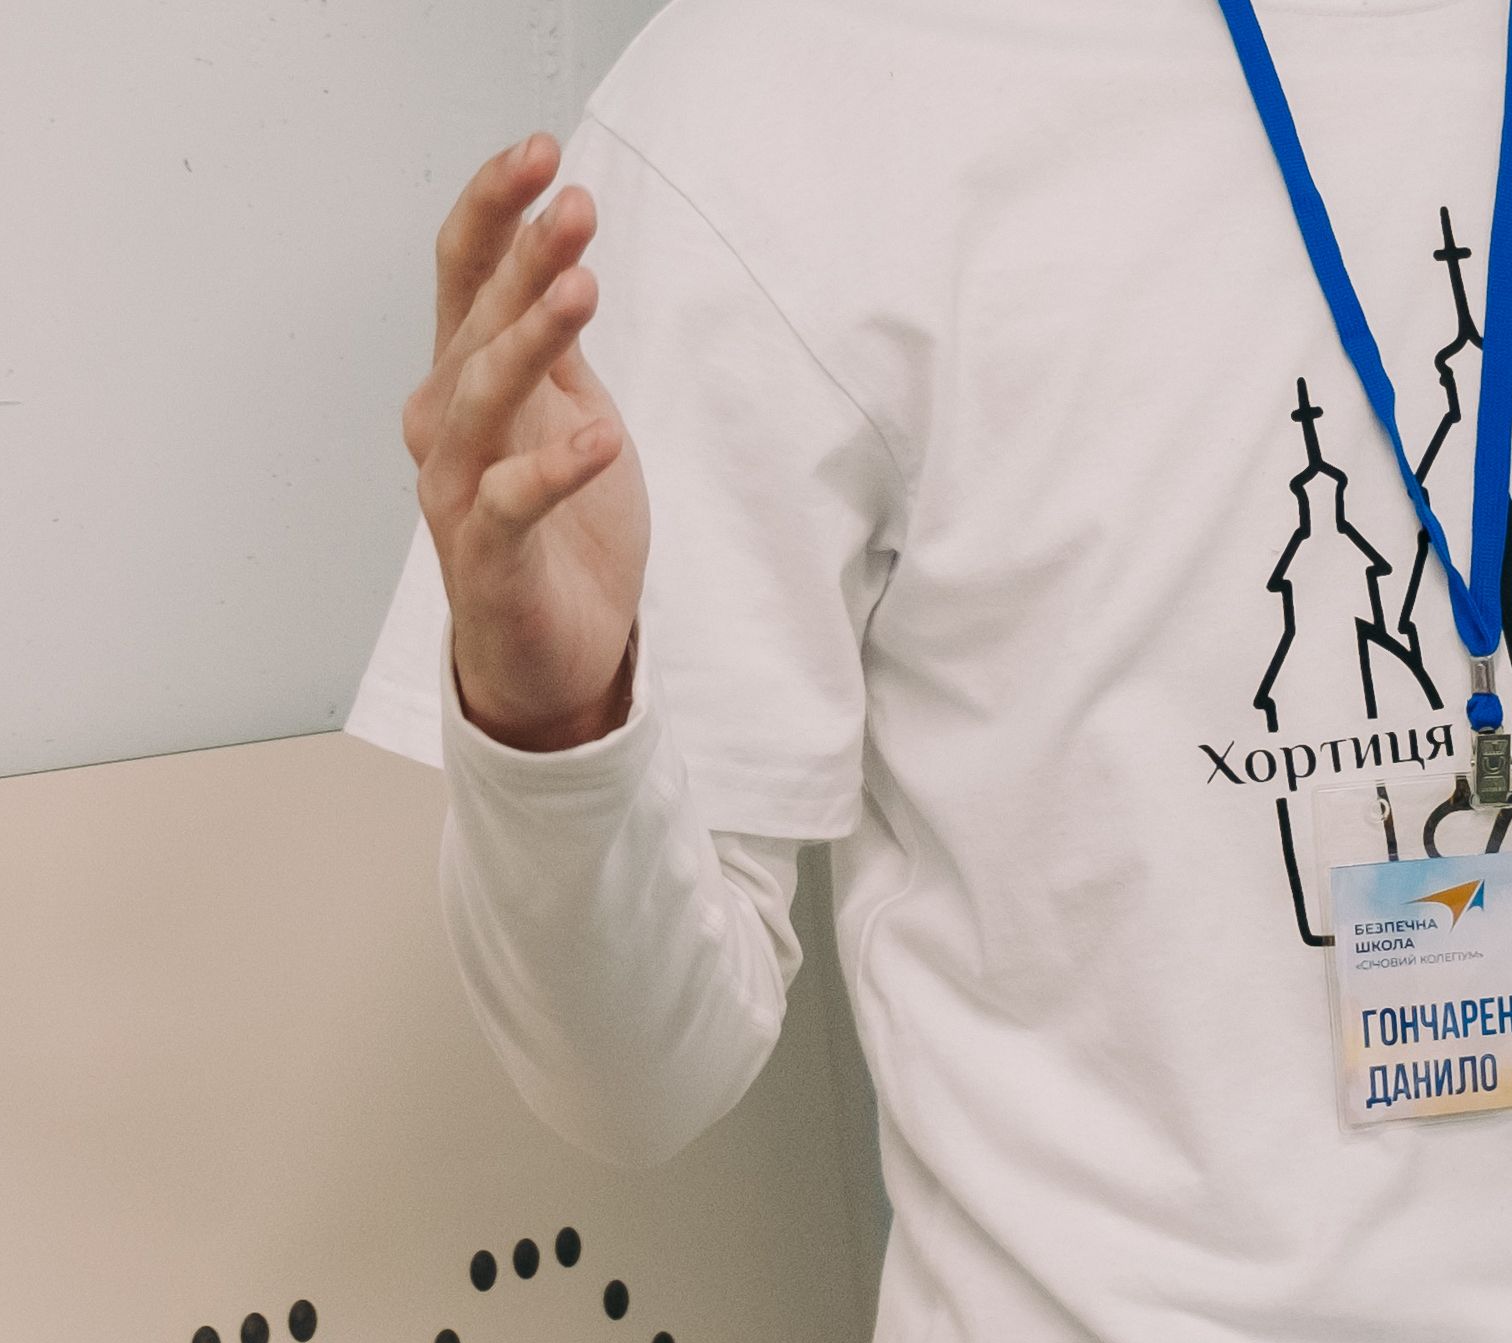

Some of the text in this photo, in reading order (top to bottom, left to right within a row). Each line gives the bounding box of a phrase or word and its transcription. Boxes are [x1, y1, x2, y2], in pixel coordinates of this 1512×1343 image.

[1197, 724, 1454, 792] Хортиця
[1354, 918, 1439, 936] БЕЗПЕЧНА
[1355, 937, 1416, 954] ШКОЛА
[1365, 1053, 1499, 1109] ДАНИЛО
